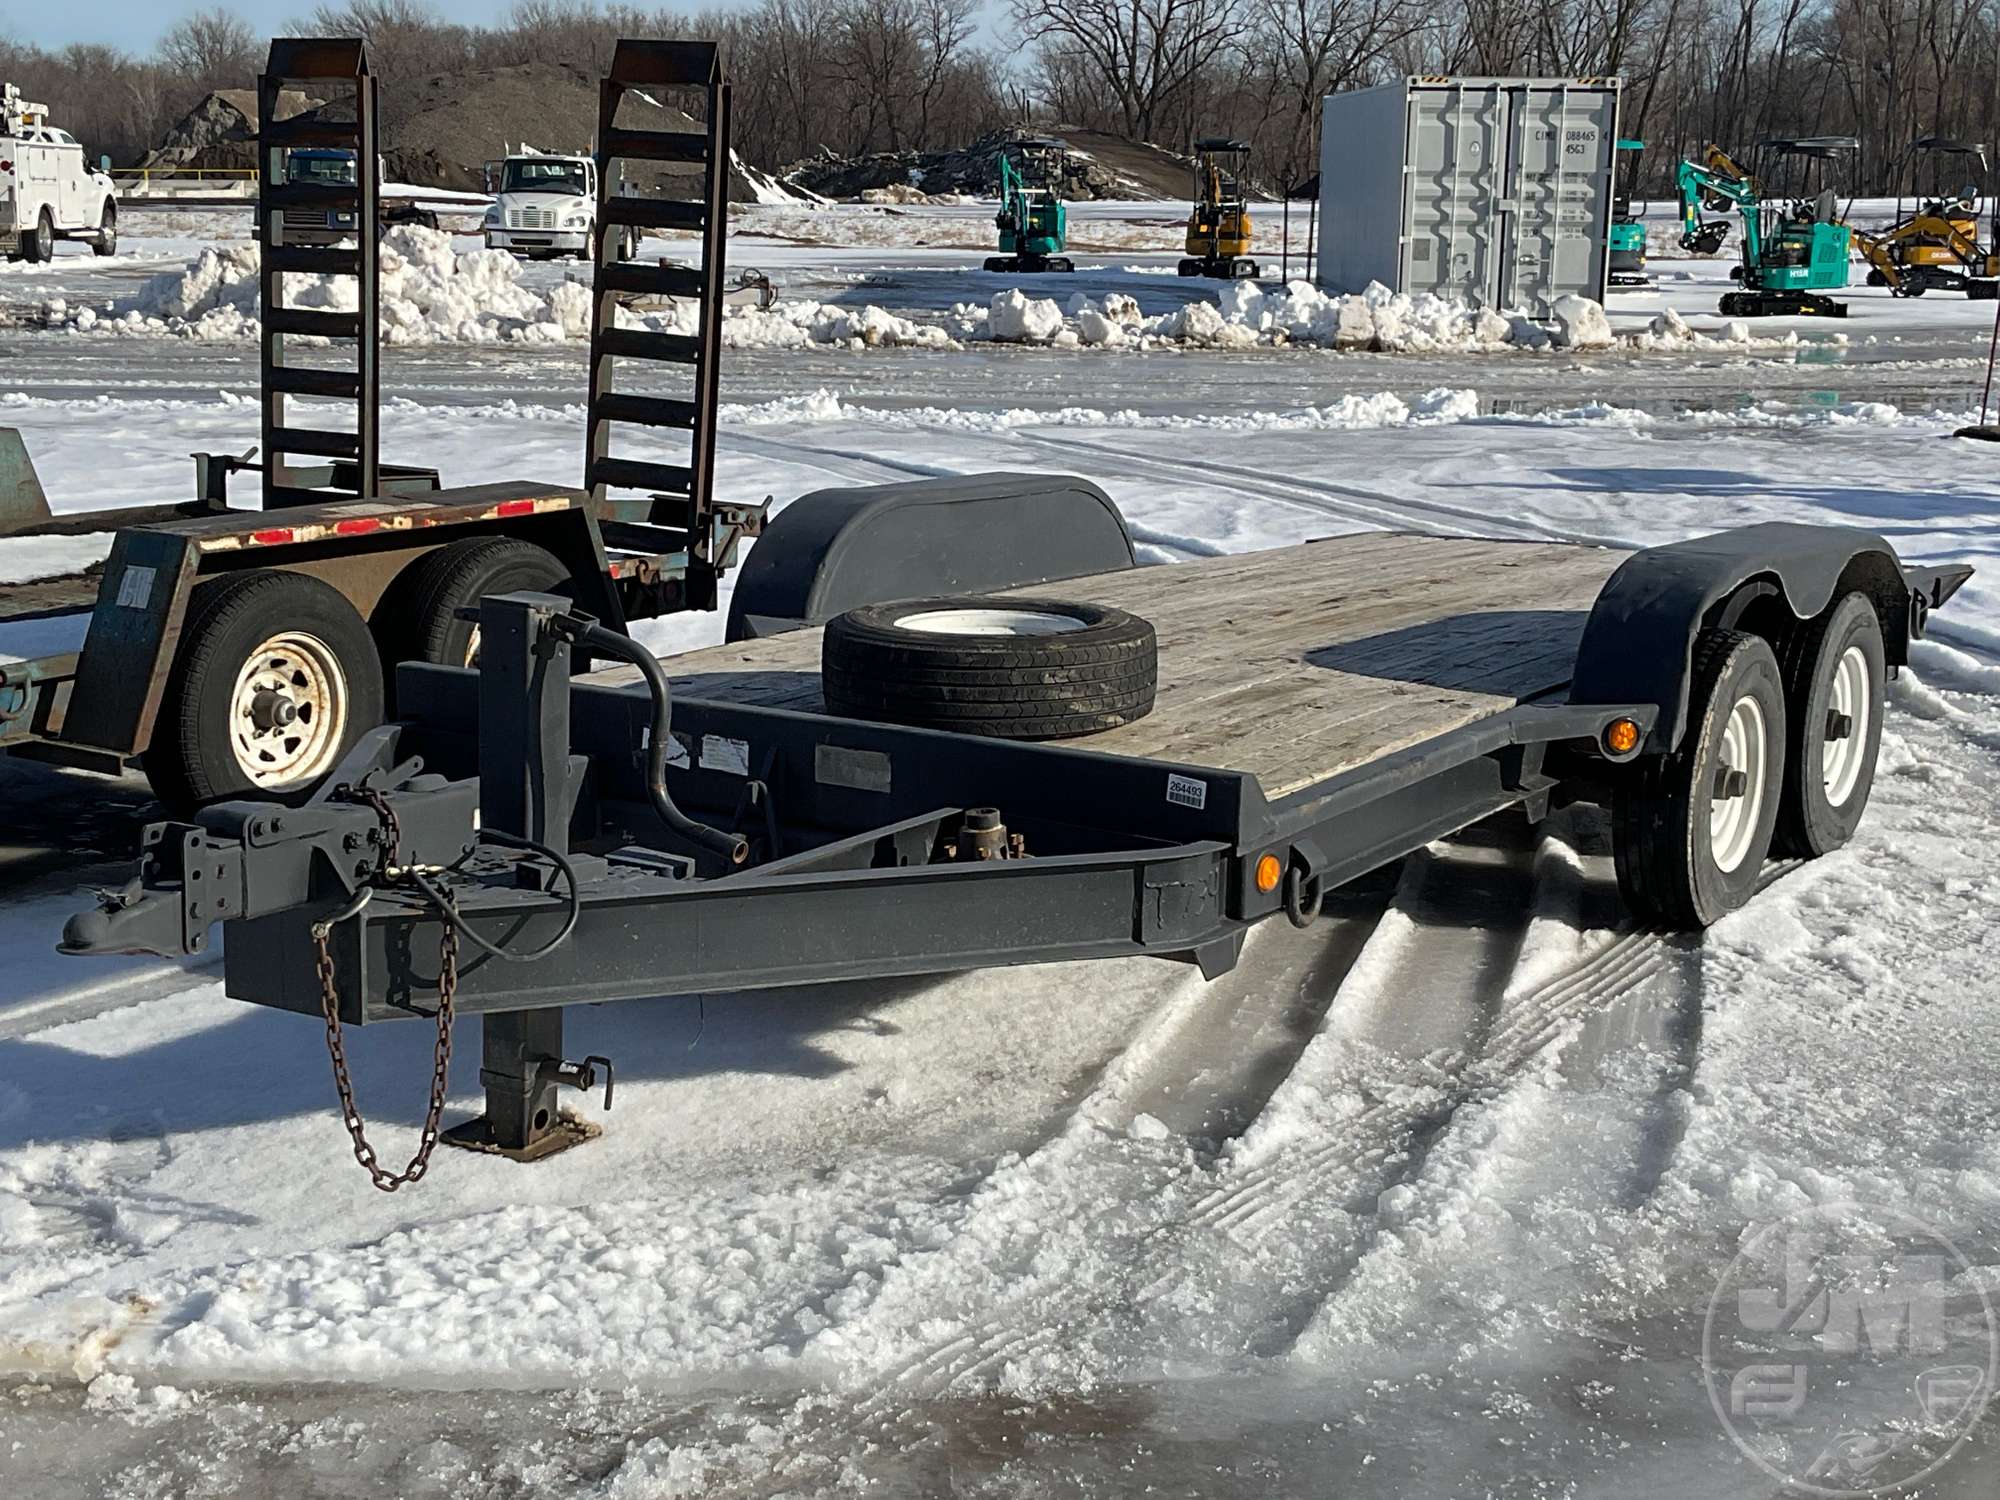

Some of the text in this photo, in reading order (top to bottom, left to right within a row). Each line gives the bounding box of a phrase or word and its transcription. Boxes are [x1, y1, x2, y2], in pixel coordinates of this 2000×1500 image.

[1566, 131, 1595, 141] 088465
[1565, 144, 1584, 154] 45G3
[1169, 781, 1202, 797] 264493
